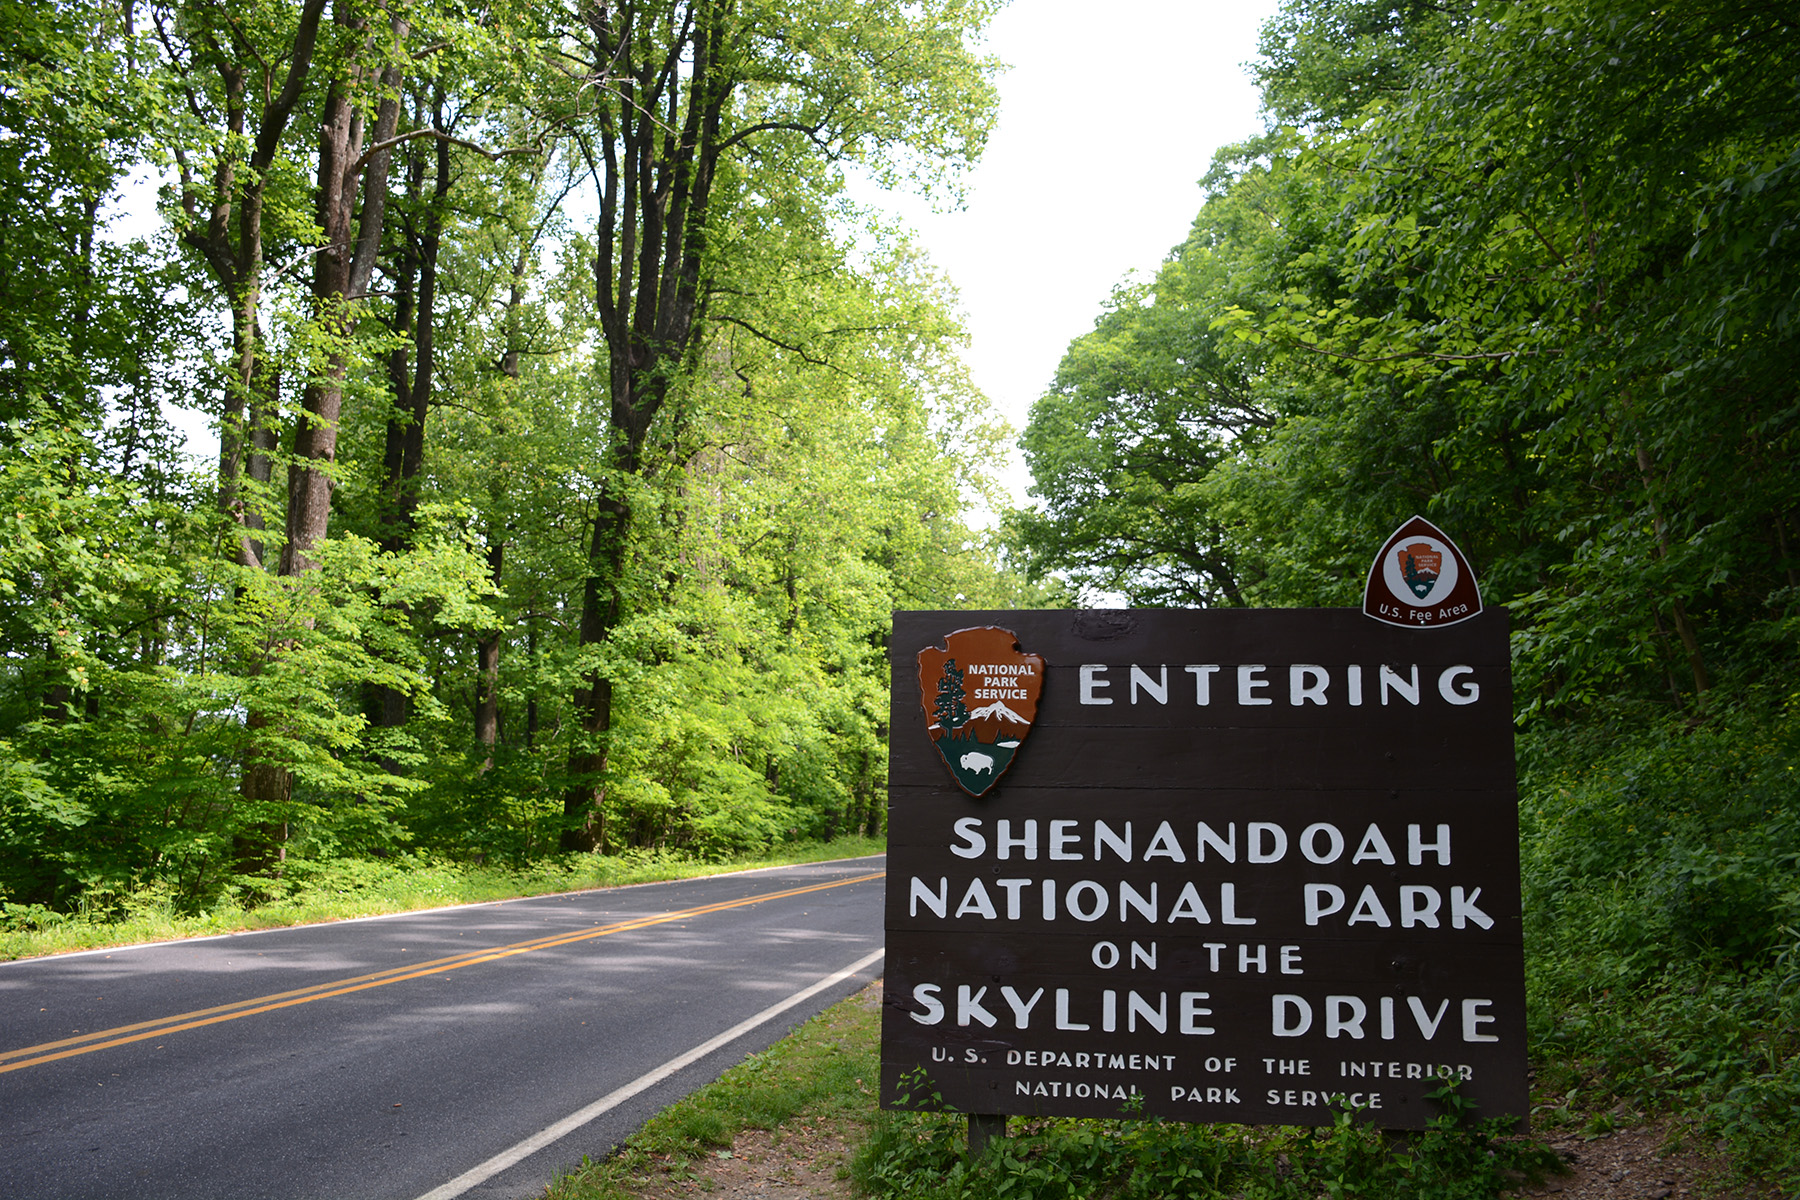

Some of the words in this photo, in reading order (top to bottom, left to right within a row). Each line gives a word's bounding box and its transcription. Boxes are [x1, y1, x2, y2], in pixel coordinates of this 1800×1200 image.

[1379, 603, 1403, 618] U.S.
[1409, 609, 1432, 621] Fee
[1439, 603, 1468, 619] Area
[968, 664, 1035, 675] NATIONAL
[984, 676, 1019, 687] PARK
[1079, 663, 1480, 706] ENTERING
[974, 688, 1028, 700] SERVICE
[949, 816, 1451, 866] SHENANDOAH
[909, 876, 1257, 926] NATIONAL
[1304, 883, 1495, 930] PARK
[1091, 940, 1157, 971] ON
[1202, 942, 1304, 975] THE
[909, 983, 1216, 1036] SKYLINE
[1272, 994, 1500, 1042] DRIVE
[1006, 1050, 1176, 1071] DEPARTMENT
[1204, 1056, 1237, 1073] OF
[1262, 1058, 1311, 1076] THE
[1340, 1061, 1473, 1081] INTERIOR
[1015, 1080, 1144, 1101] NATIONAL
[1171, 1086, 1241, 1104] PARK
